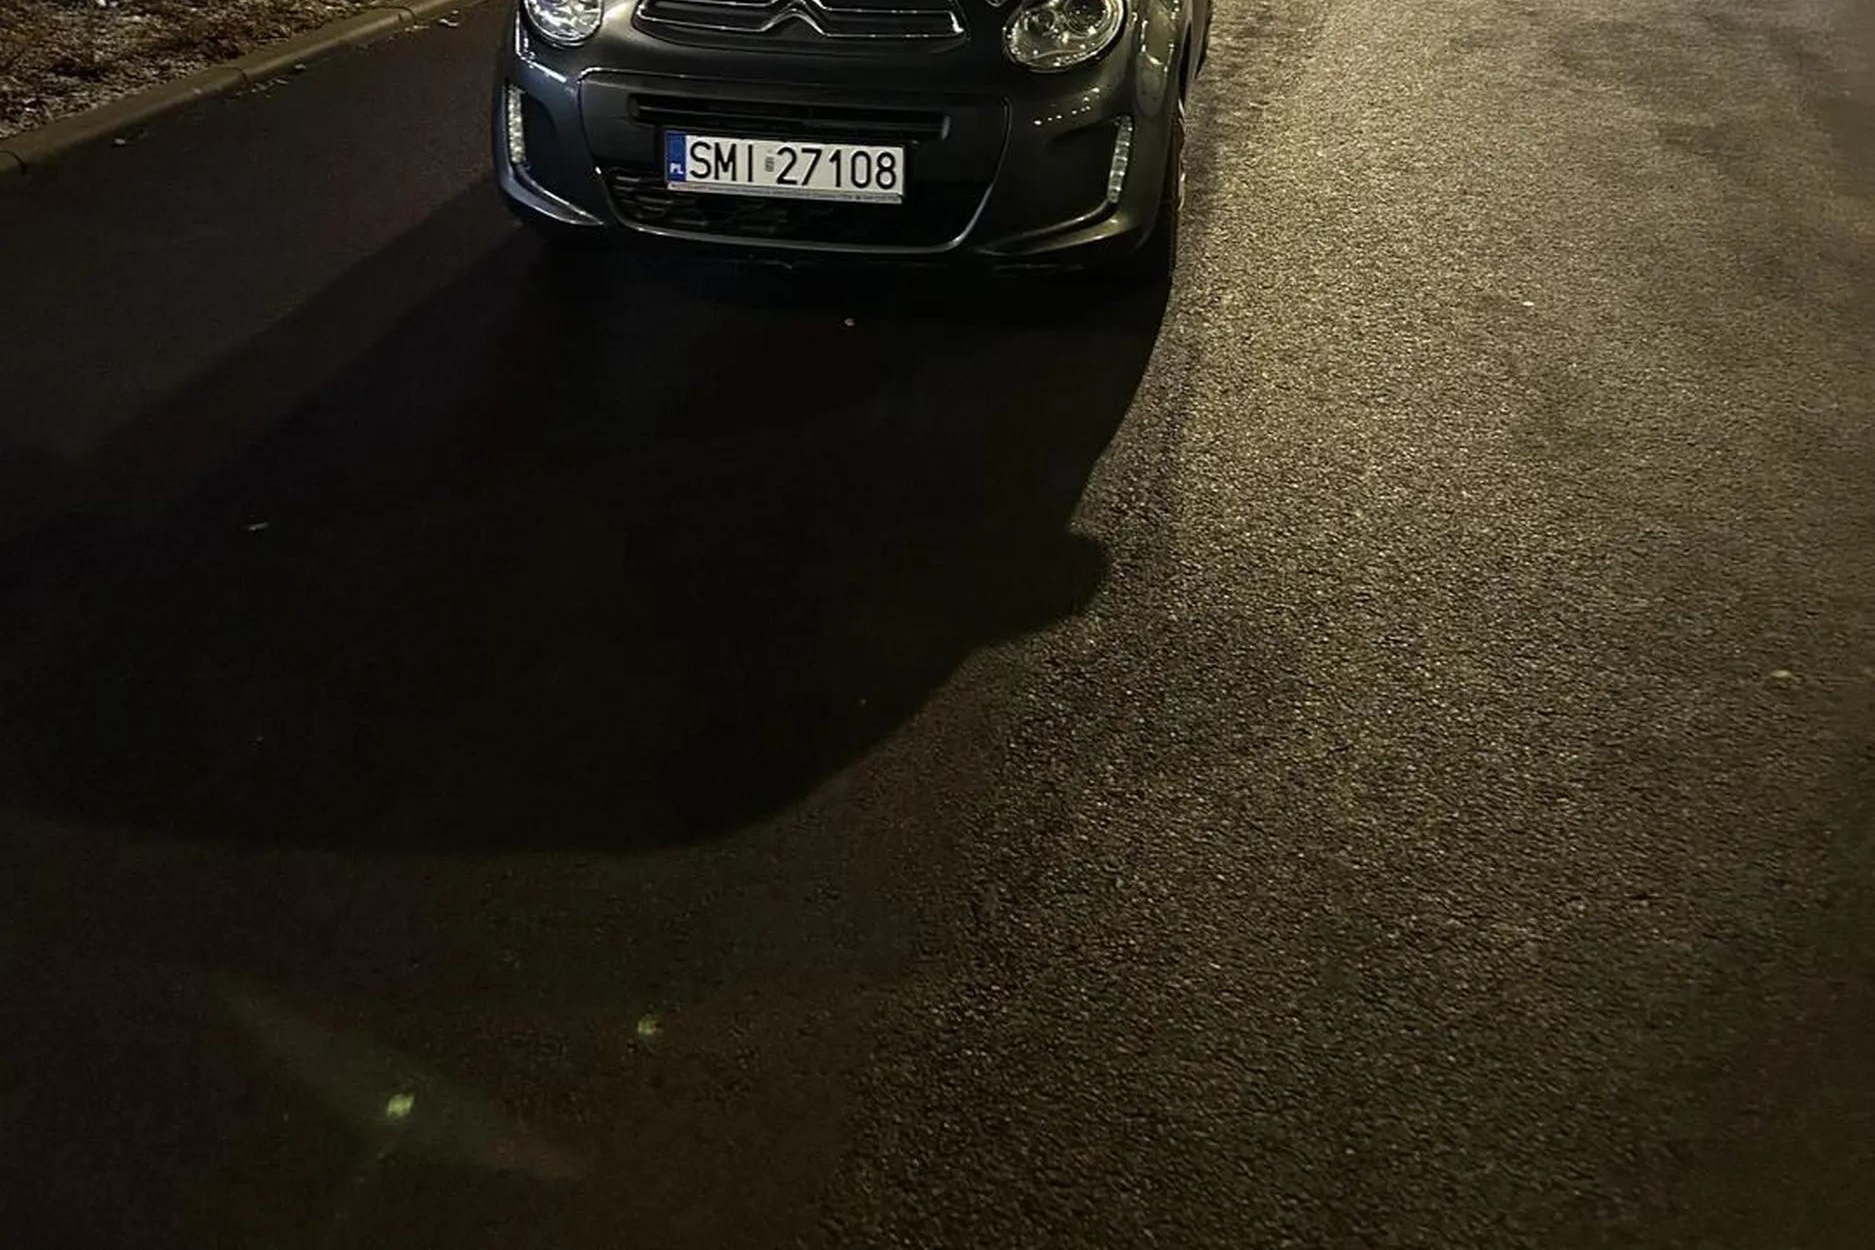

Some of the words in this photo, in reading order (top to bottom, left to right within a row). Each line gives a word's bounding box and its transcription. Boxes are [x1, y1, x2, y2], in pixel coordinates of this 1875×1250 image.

[670, 163, 684, 175] PL
[690, 141, 753, 182] SMI
[776, 147, 896, 189] 27108
